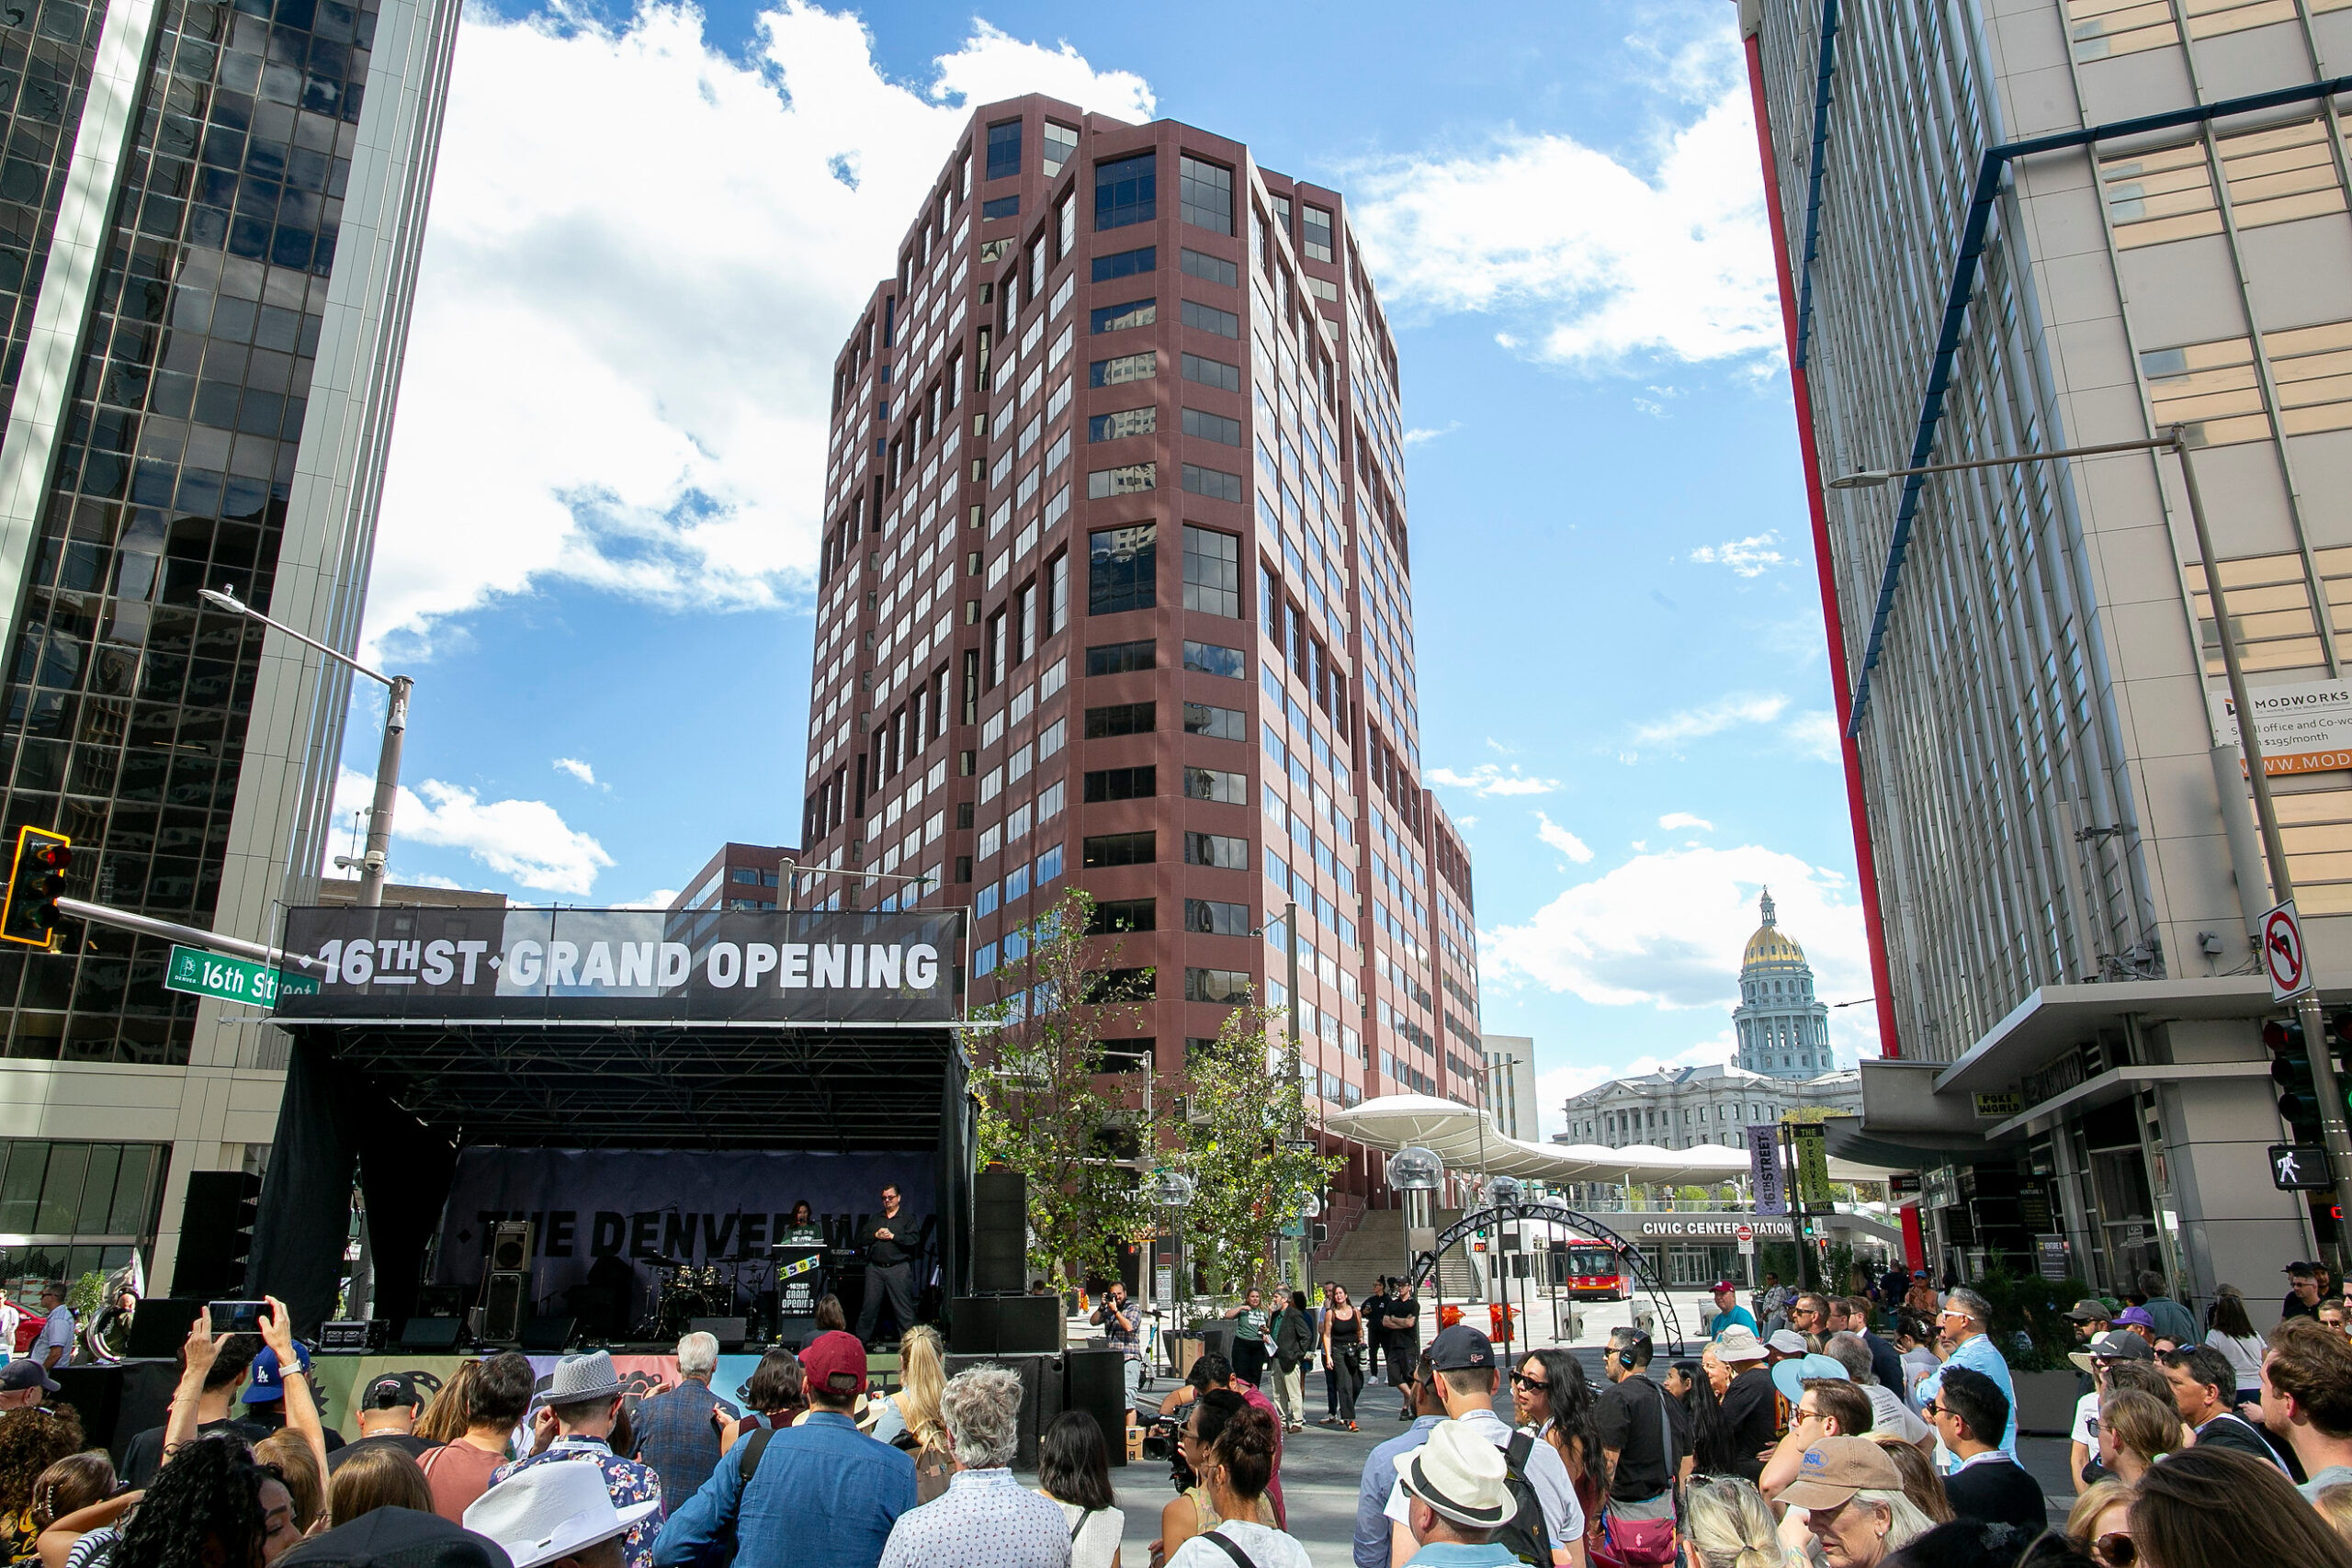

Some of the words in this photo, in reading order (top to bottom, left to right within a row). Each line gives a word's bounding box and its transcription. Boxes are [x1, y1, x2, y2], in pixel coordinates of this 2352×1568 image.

[2255, 691, 2349, 709] MODWORKS
[2231, 723, 2261, 736] Sll
[2264, 723, 2294, 733] office
[2297, 717, 2316, 729] and
[2264, 732, 2329, 747] $195/month
[2240, 752, 2352, 773] WW.MOD
[509, 940, 692, 987] GRAND
[707, 941, 938, 989] OPENING
[175, 975, 197, 984] DENVER
[201, 961, 244, 993] 16th
[1979, 1103, 2020, 1113] WORLD
[1806, 1139, 1819, 1200] DENVER
[1809, 1203, 1828, 1212] WAY
[1643, 1222, 1682, 1235] CIVIC
[1687, 1222, 1740, 1235] CENTER
[257, 1365, 268, 1382] LA
